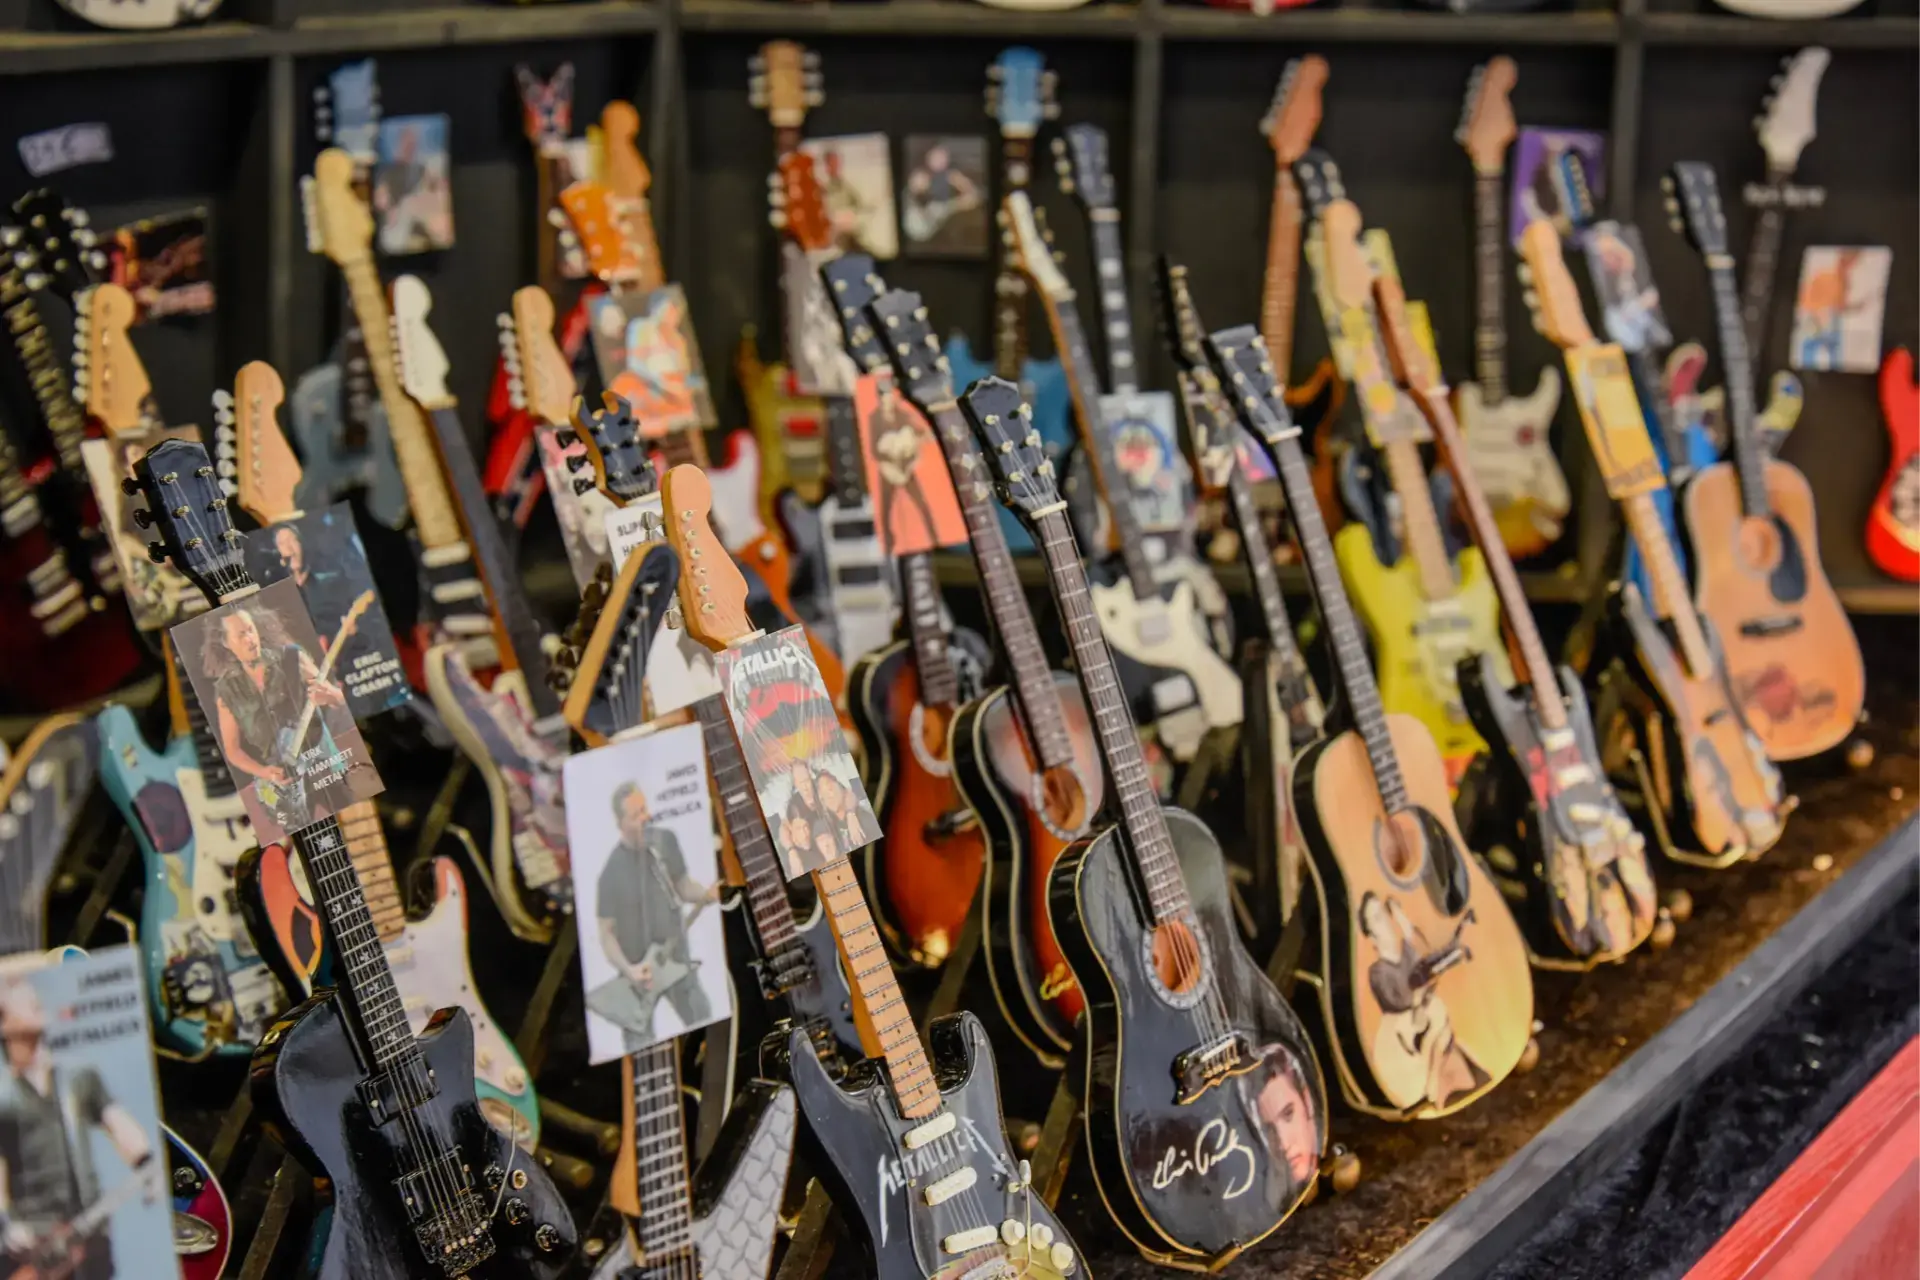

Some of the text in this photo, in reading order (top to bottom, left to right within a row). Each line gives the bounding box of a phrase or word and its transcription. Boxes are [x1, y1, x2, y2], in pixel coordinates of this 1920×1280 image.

[345, 658, 400, 685] CLAPTON
[353, 651, 383, 669] ERIC
[352, 676, 393, 697] CRASH
[300, 745, 324, 762] KIRK
[307, 747, 353, 777] HAMMETT
[877, 1115, 1009, 1248] METALLICA
